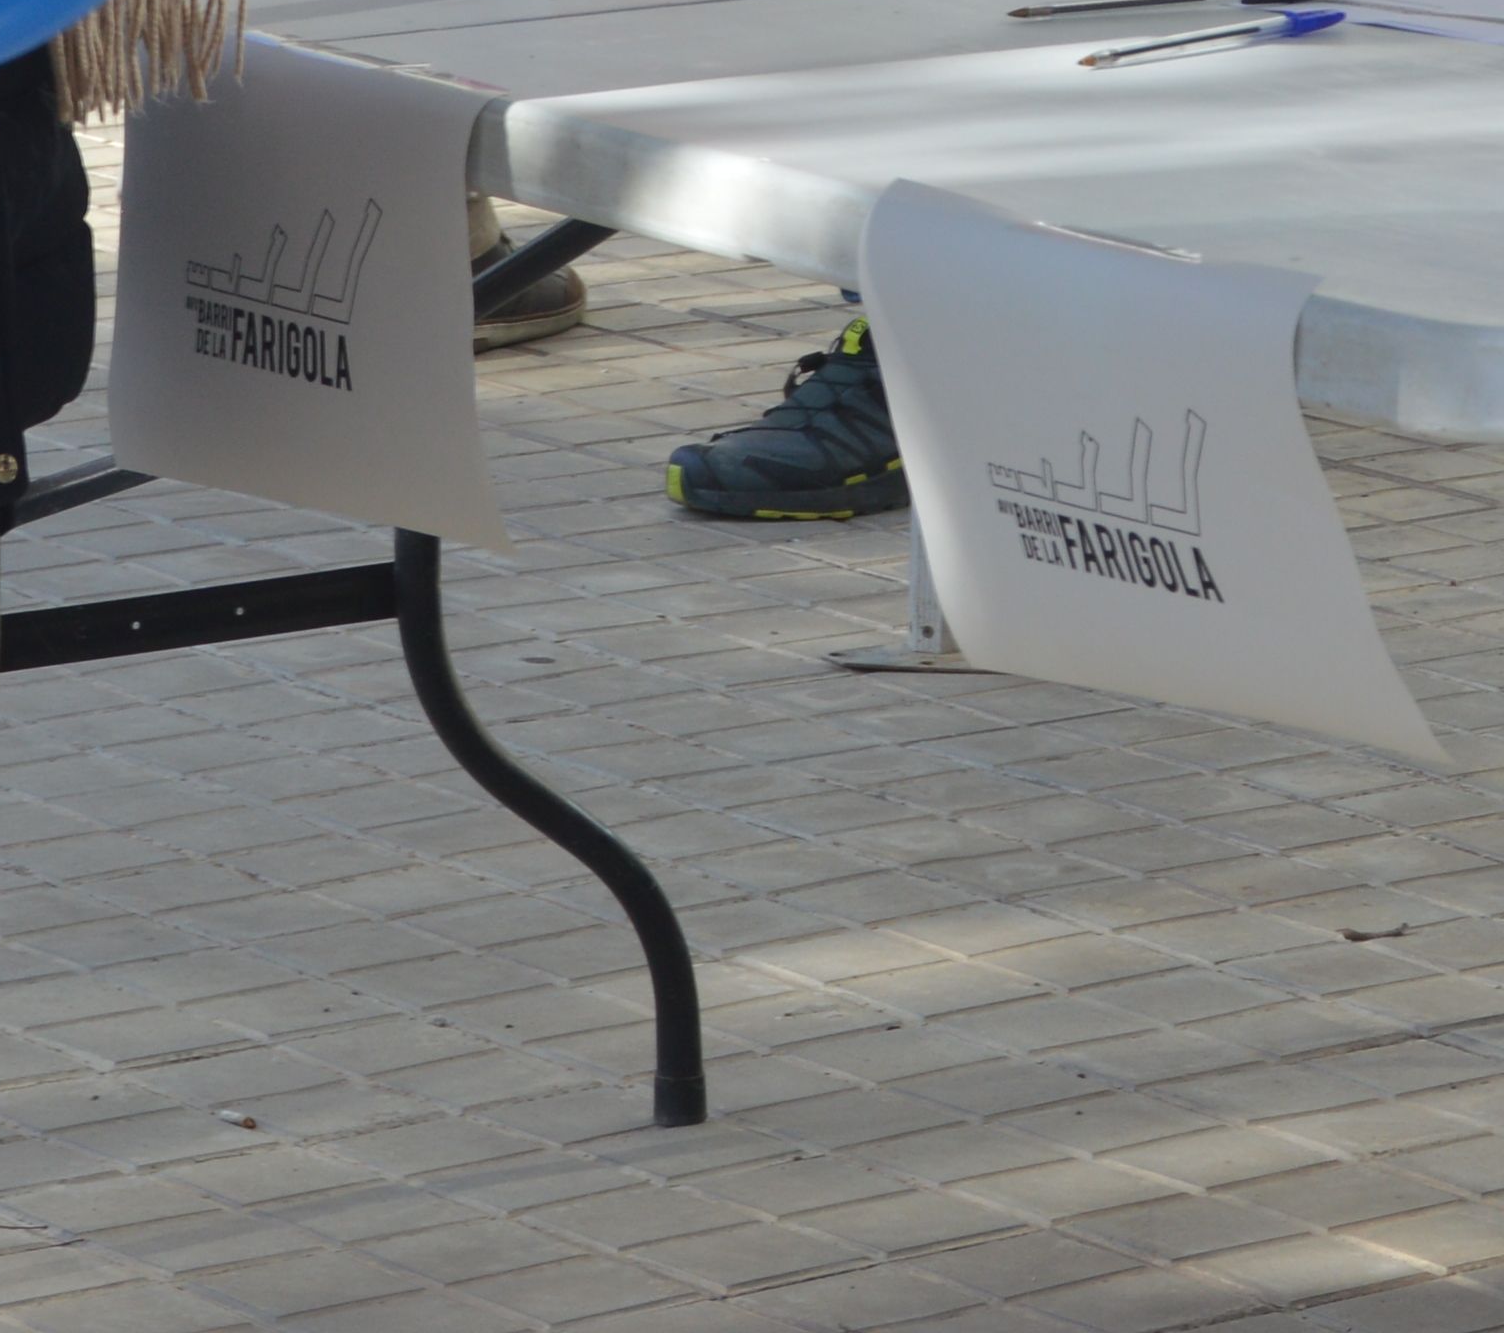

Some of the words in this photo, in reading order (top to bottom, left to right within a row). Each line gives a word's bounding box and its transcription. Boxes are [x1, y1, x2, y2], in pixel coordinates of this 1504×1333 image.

[198, 298, 233, 331] BARRI
[196, 328, 210, 355] DE
[212, 333, 226, 359] LA
[231, 308, 353, 391] FARIGOLA
[1013, 502, 1062, 537] BARRI
[1021, 533, 1044, 562] DE
[1043, 539, 1064, 567] LA
[1057, 514, 1225, 604] FARIGOLA
